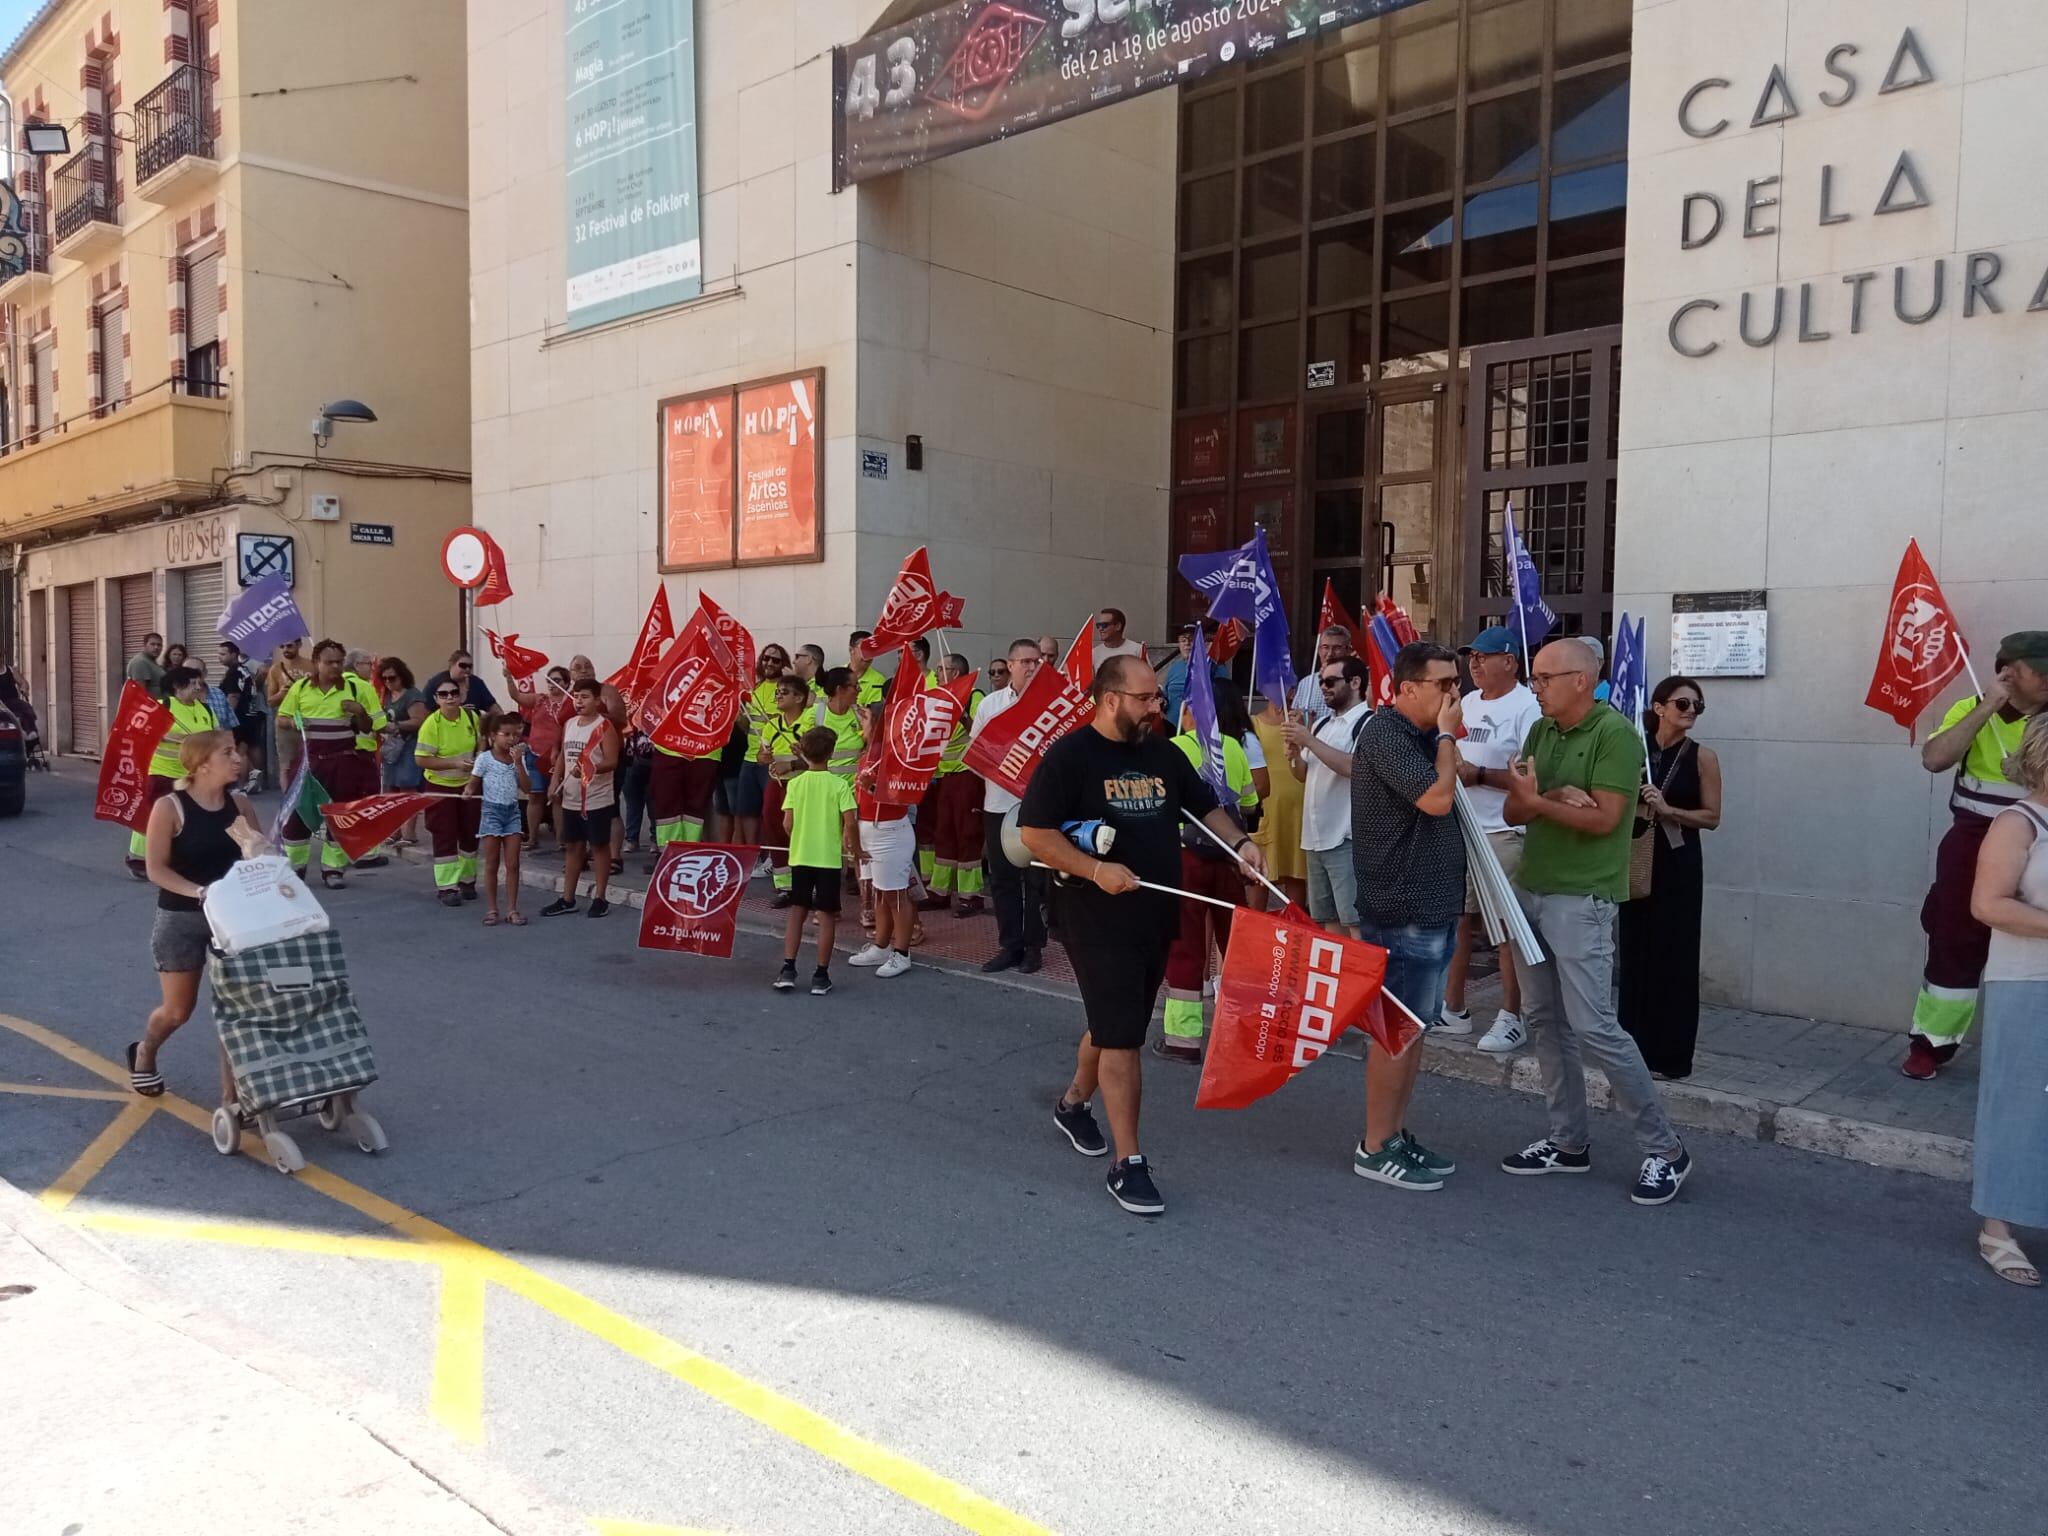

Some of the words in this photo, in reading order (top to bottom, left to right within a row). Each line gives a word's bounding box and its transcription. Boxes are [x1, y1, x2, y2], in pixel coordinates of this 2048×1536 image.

[1061, 55, 1086, 80] del
[1088, 50, 1099, 71] 2
[1103, 49, 1118, 66] al
[1123, 35, 1142, 60] 18
[1147, 28, 1167, 51] de
[1171, 9, 1231, 44] agosto
[845, 36, 916, 122] 43
[1677, 26, 1934, 139] CASA
[575, 221, 587, 244] 32
[589, 210, 627, 239] Festival
[630, 204, 643, 224] de
[646, 191, 690, 220] Folklore
[1680, 175, 1779, 250] DE
[1818, 150, 1931, 226] LA
[748, 480, 787, 503] Artes
[775, 465, 787, 477] de
[360, 527, 384, 535] CALLE
[919, 696, 953, 757] UGT
[1463, 728, 1491, 743] UMA
[1104, 777, 1166, 800] FLYNN'S
[1122, 799, 1155, 811] ARCADE
[237, 862, 265, 874] 100
[1268, 945, 1286, 998] @ccoopv
[1291, 937, 1344, 1068] CCOO
[1255, 1020, 1270, 1061] ccoopv
